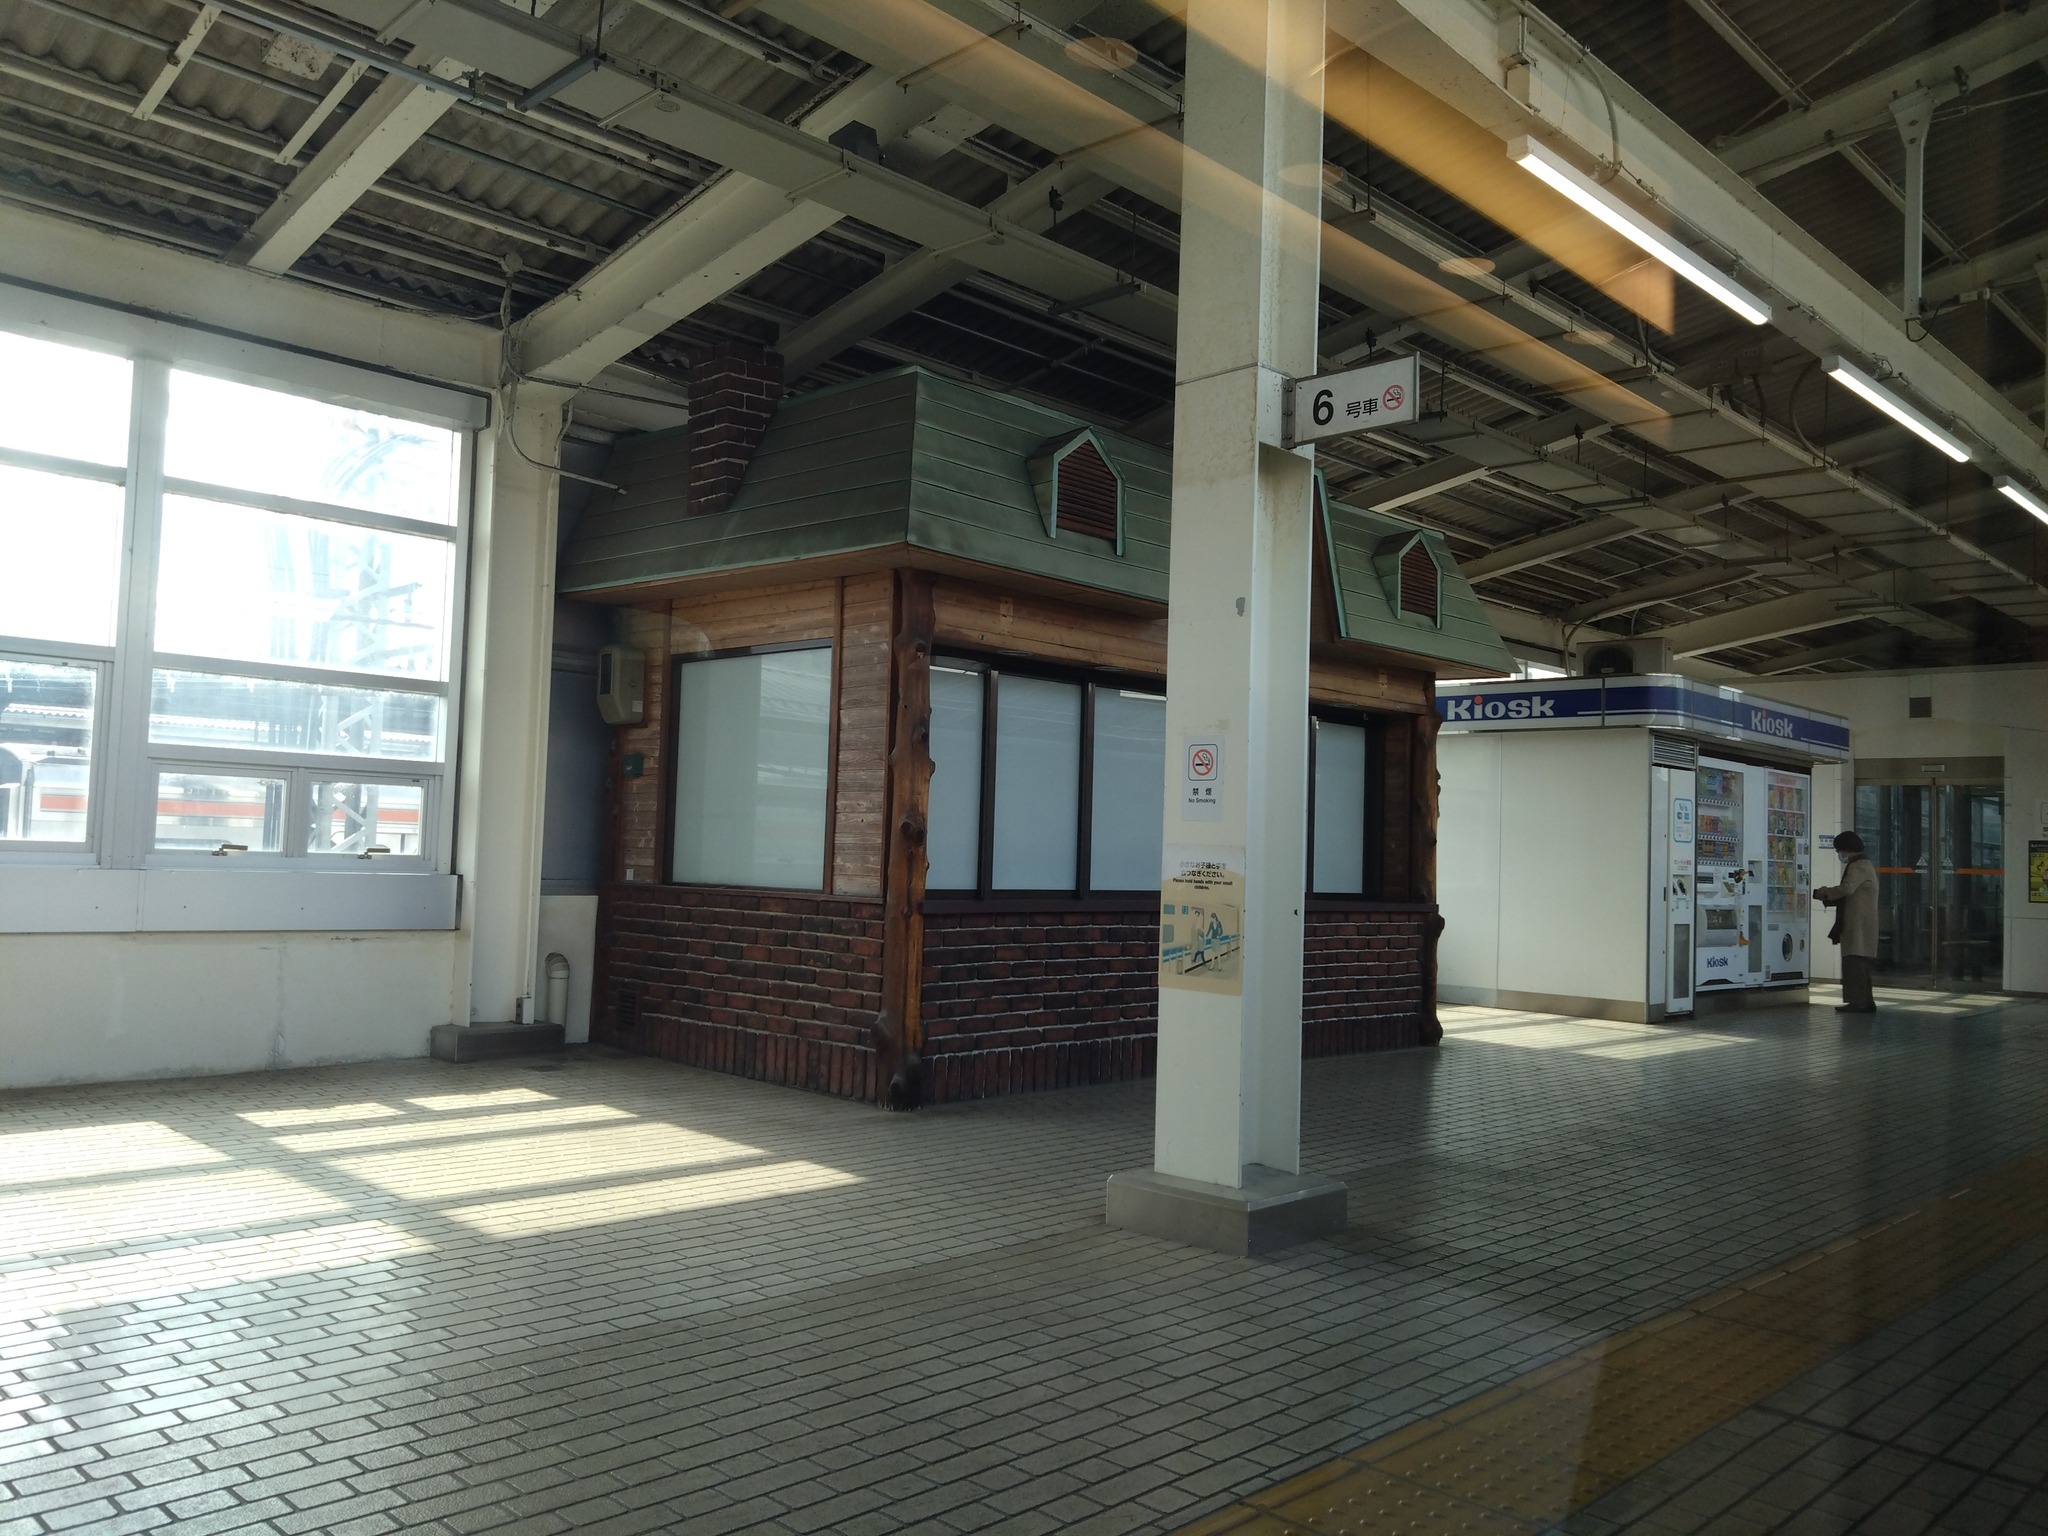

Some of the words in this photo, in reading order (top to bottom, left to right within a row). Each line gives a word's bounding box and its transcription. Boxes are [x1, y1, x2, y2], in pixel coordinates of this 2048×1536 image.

[1313, 389, 1334, 426] 6
[1345, 398, 1379, 419] 号車
[1447, 695, 1556, 721] Kiosk
[1751, 707, 1794, 738] Kiosk
[1706, 956, 1729, 968] Kiosk
